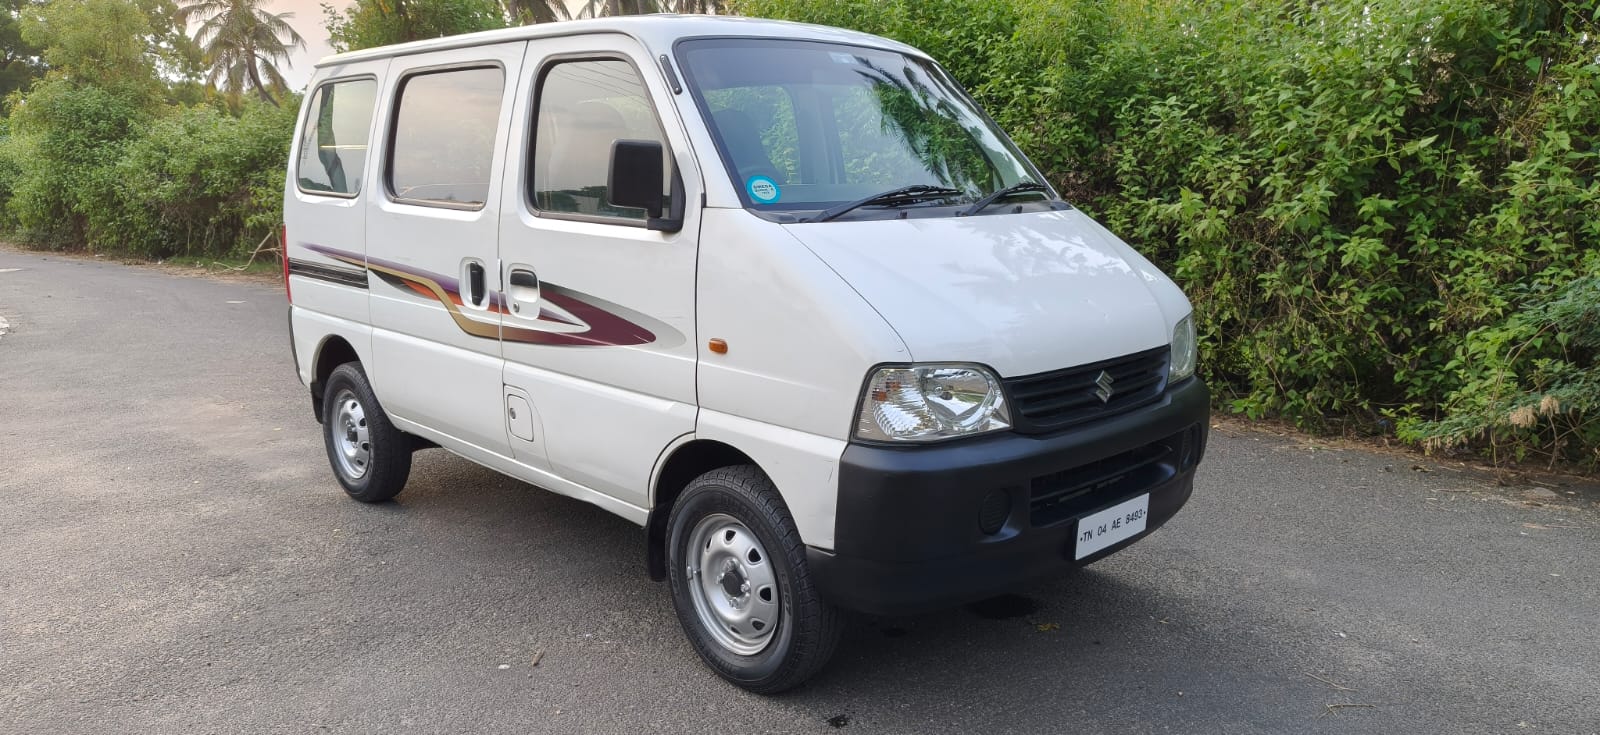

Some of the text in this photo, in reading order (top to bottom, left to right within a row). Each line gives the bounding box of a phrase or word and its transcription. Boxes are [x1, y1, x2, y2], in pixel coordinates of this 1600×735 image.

[1083, 508, 1143, 542] TN 04 AE 8493
